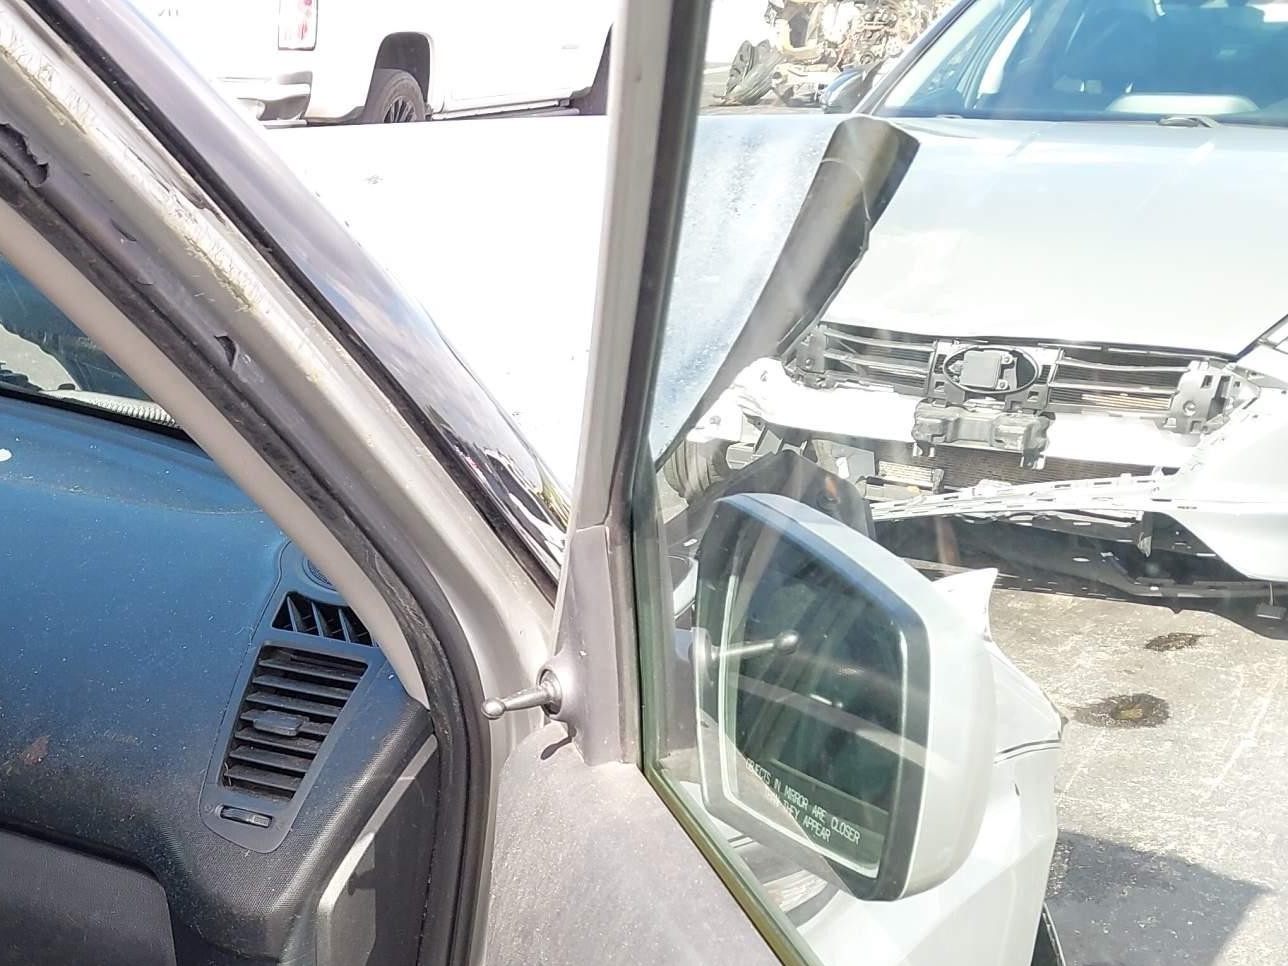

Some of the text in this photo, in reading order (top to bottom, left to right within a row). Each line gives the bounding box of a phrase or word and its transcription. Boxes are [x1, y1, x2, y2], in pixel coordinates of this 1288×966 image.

[773, 778, 781, 792] IN
[784, 785, 808, 810] MIRROR
[812, 804, 827, 825] ARE
[831, 816, 860, 845] CLOSER
[803, 815, 830, 842] APPEAR
